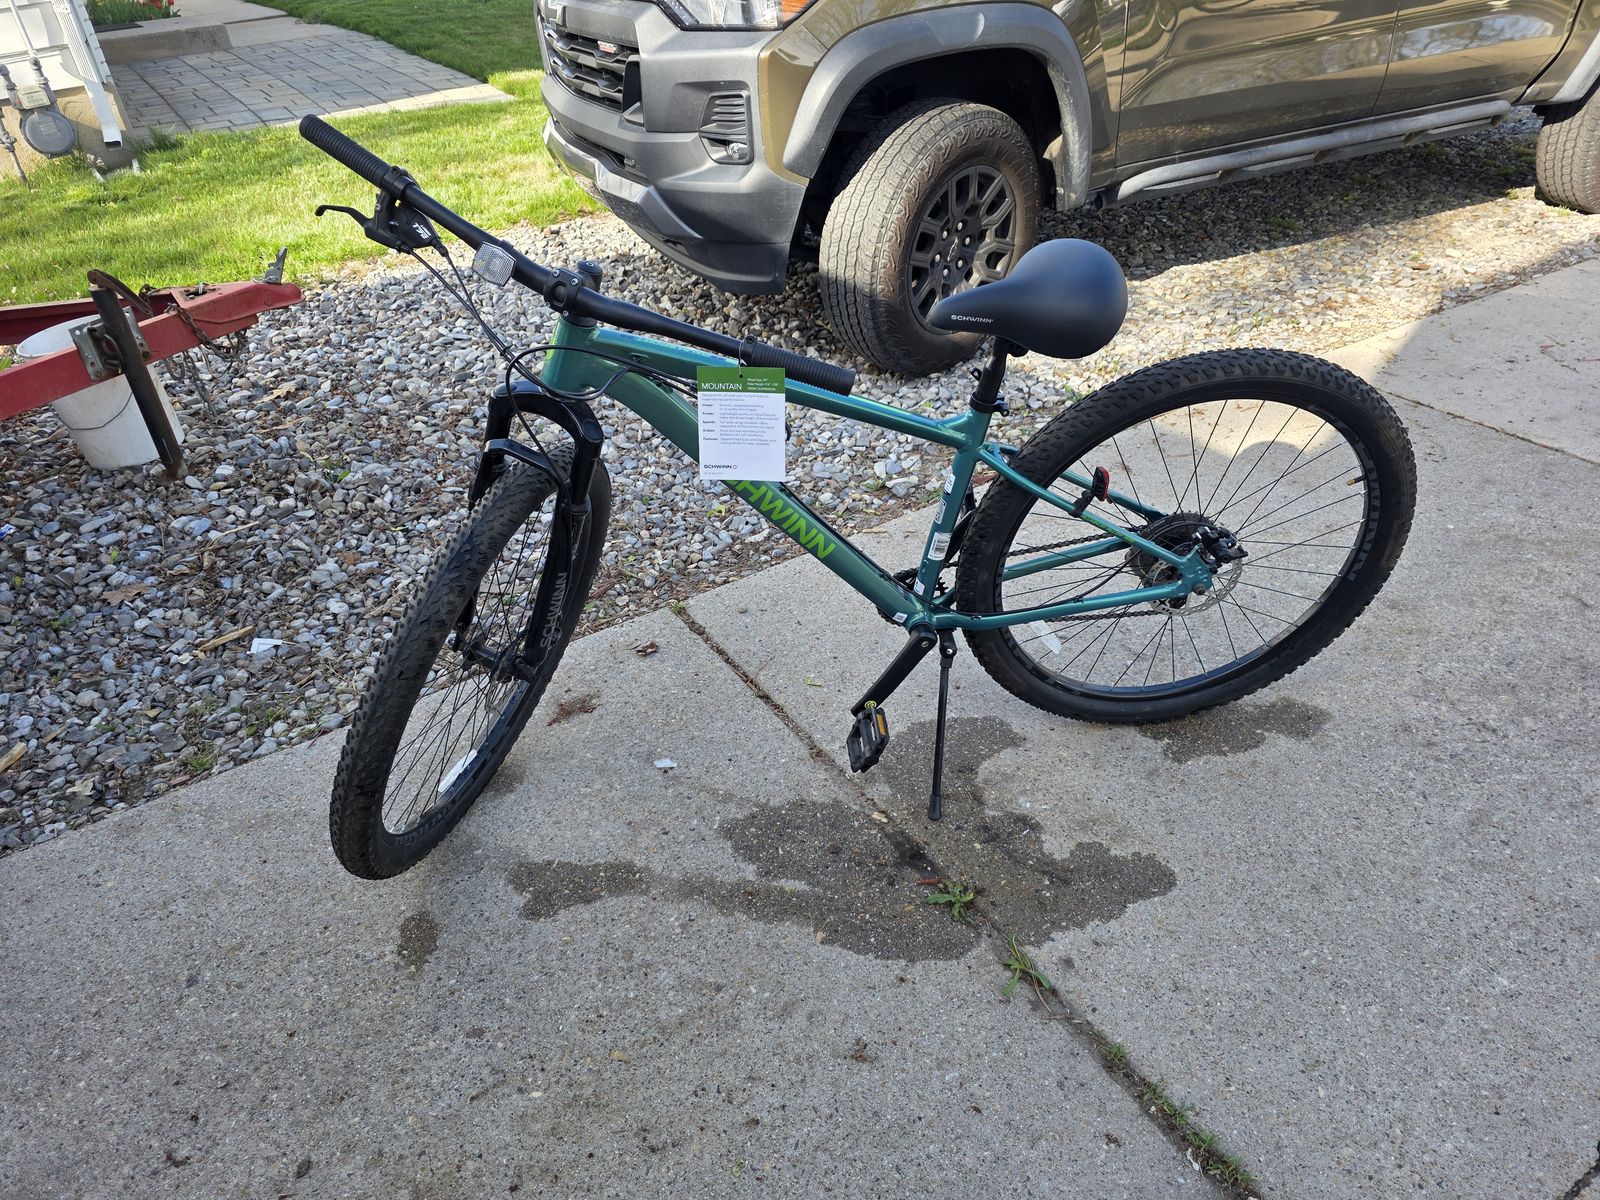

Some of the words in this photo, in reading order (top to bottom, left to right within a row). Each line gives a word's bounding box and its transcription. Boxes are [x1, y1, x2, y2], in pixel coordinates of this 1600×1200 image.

[950, 314, 992, 324] SCHWINN
[701, 382, 742, 390] MOUNTAIN
[727, 480, 836, 559] HWINN
[540, 572, 567, 647] SCHWINN
